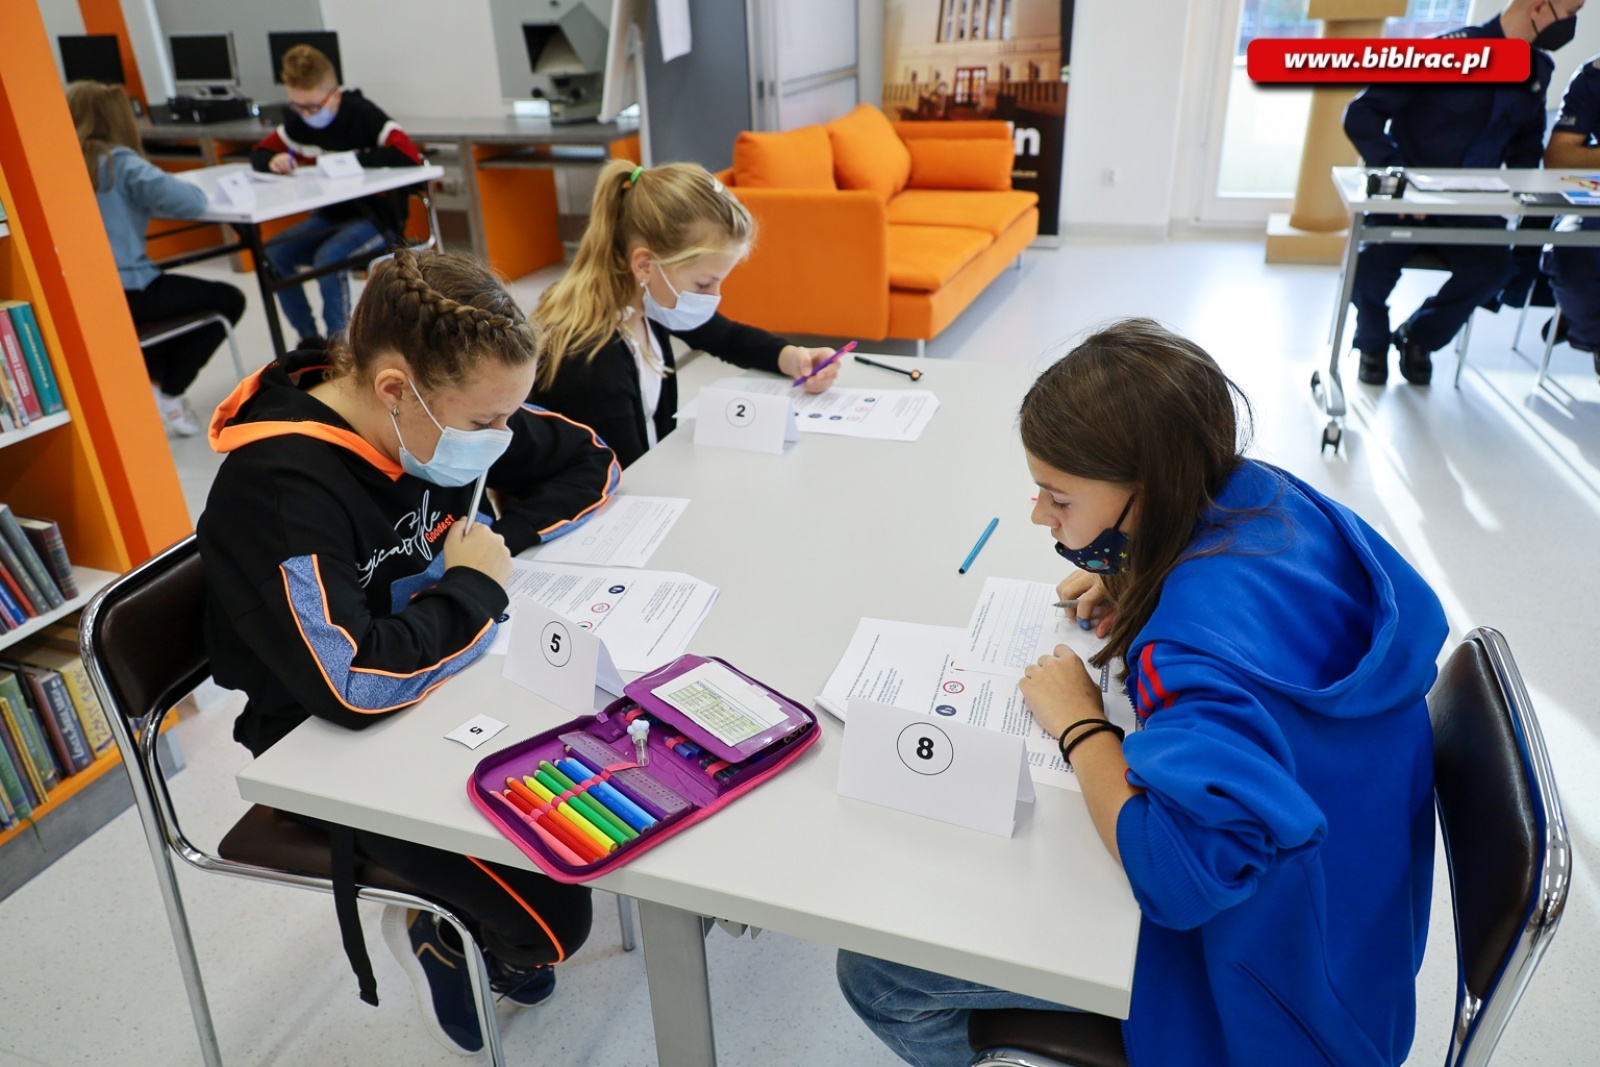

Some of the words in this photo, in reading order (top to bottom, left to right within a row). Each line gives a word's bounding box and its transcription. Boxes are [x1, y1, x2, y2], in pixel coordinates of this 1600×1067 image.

[735, 404, 746, 418] 2
[424, 513, 455, 543] Goodest
[549, 634, 562, 654] 5
[469, 725, 483, 736] 5
[915, 736, 934, 761] 8
